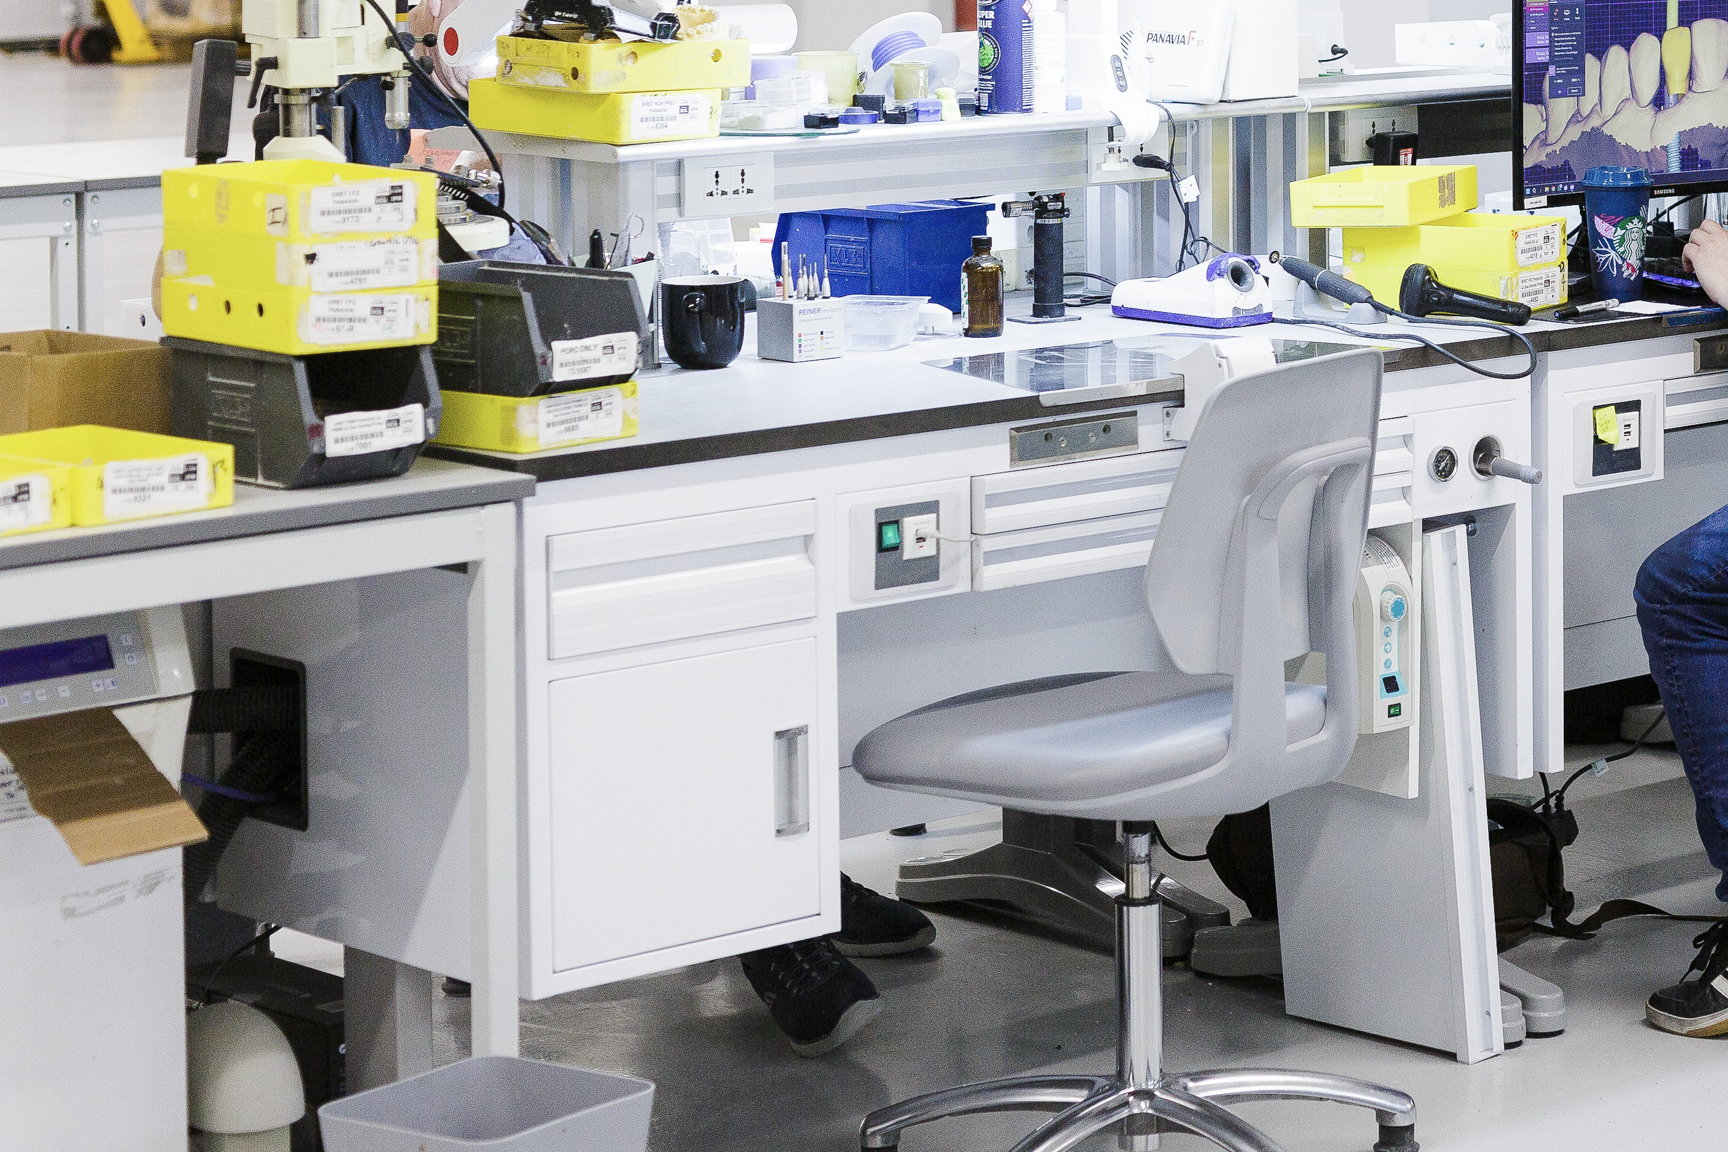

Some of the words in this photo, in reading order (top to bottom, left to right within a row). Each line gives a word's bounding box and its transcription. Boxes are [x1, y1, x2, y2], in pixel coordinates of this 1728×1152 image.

[976, 10, 996, 21] UPER
[1146, 32, 1186, 46] PANAVIA
[1186, 30, 1197, 46] F
[798, 308, 822, 316] REINER
[580, 344, 598, 352] ONLY
